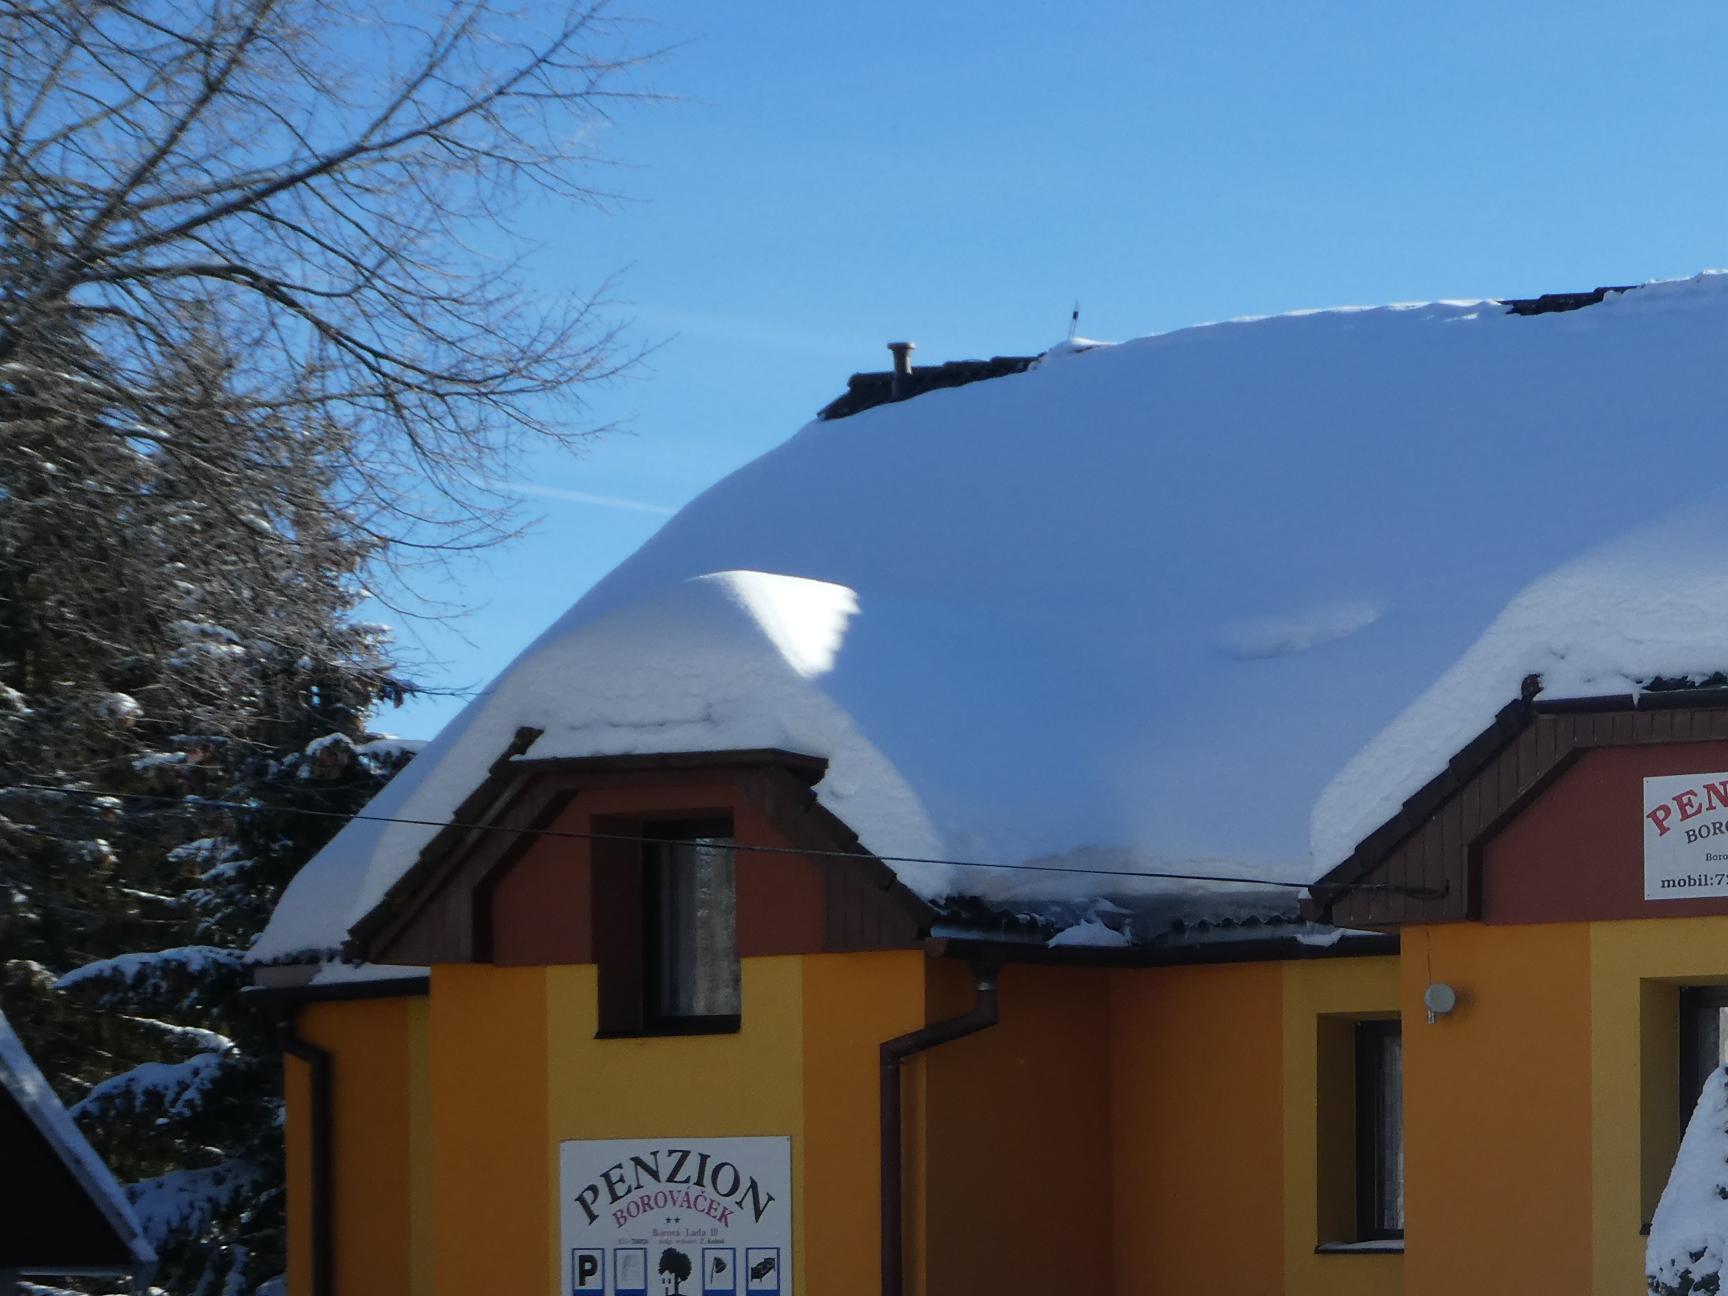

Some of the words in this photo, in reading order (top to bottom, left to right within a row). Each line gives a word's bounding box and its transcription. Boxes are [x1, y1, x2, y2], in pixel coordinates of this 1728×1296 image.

[574, 1149, 776, 1226] PENZION
[612, 1187, 735, 1229] BOROVÁČEK
[578, 1254, 598, 1286] P
